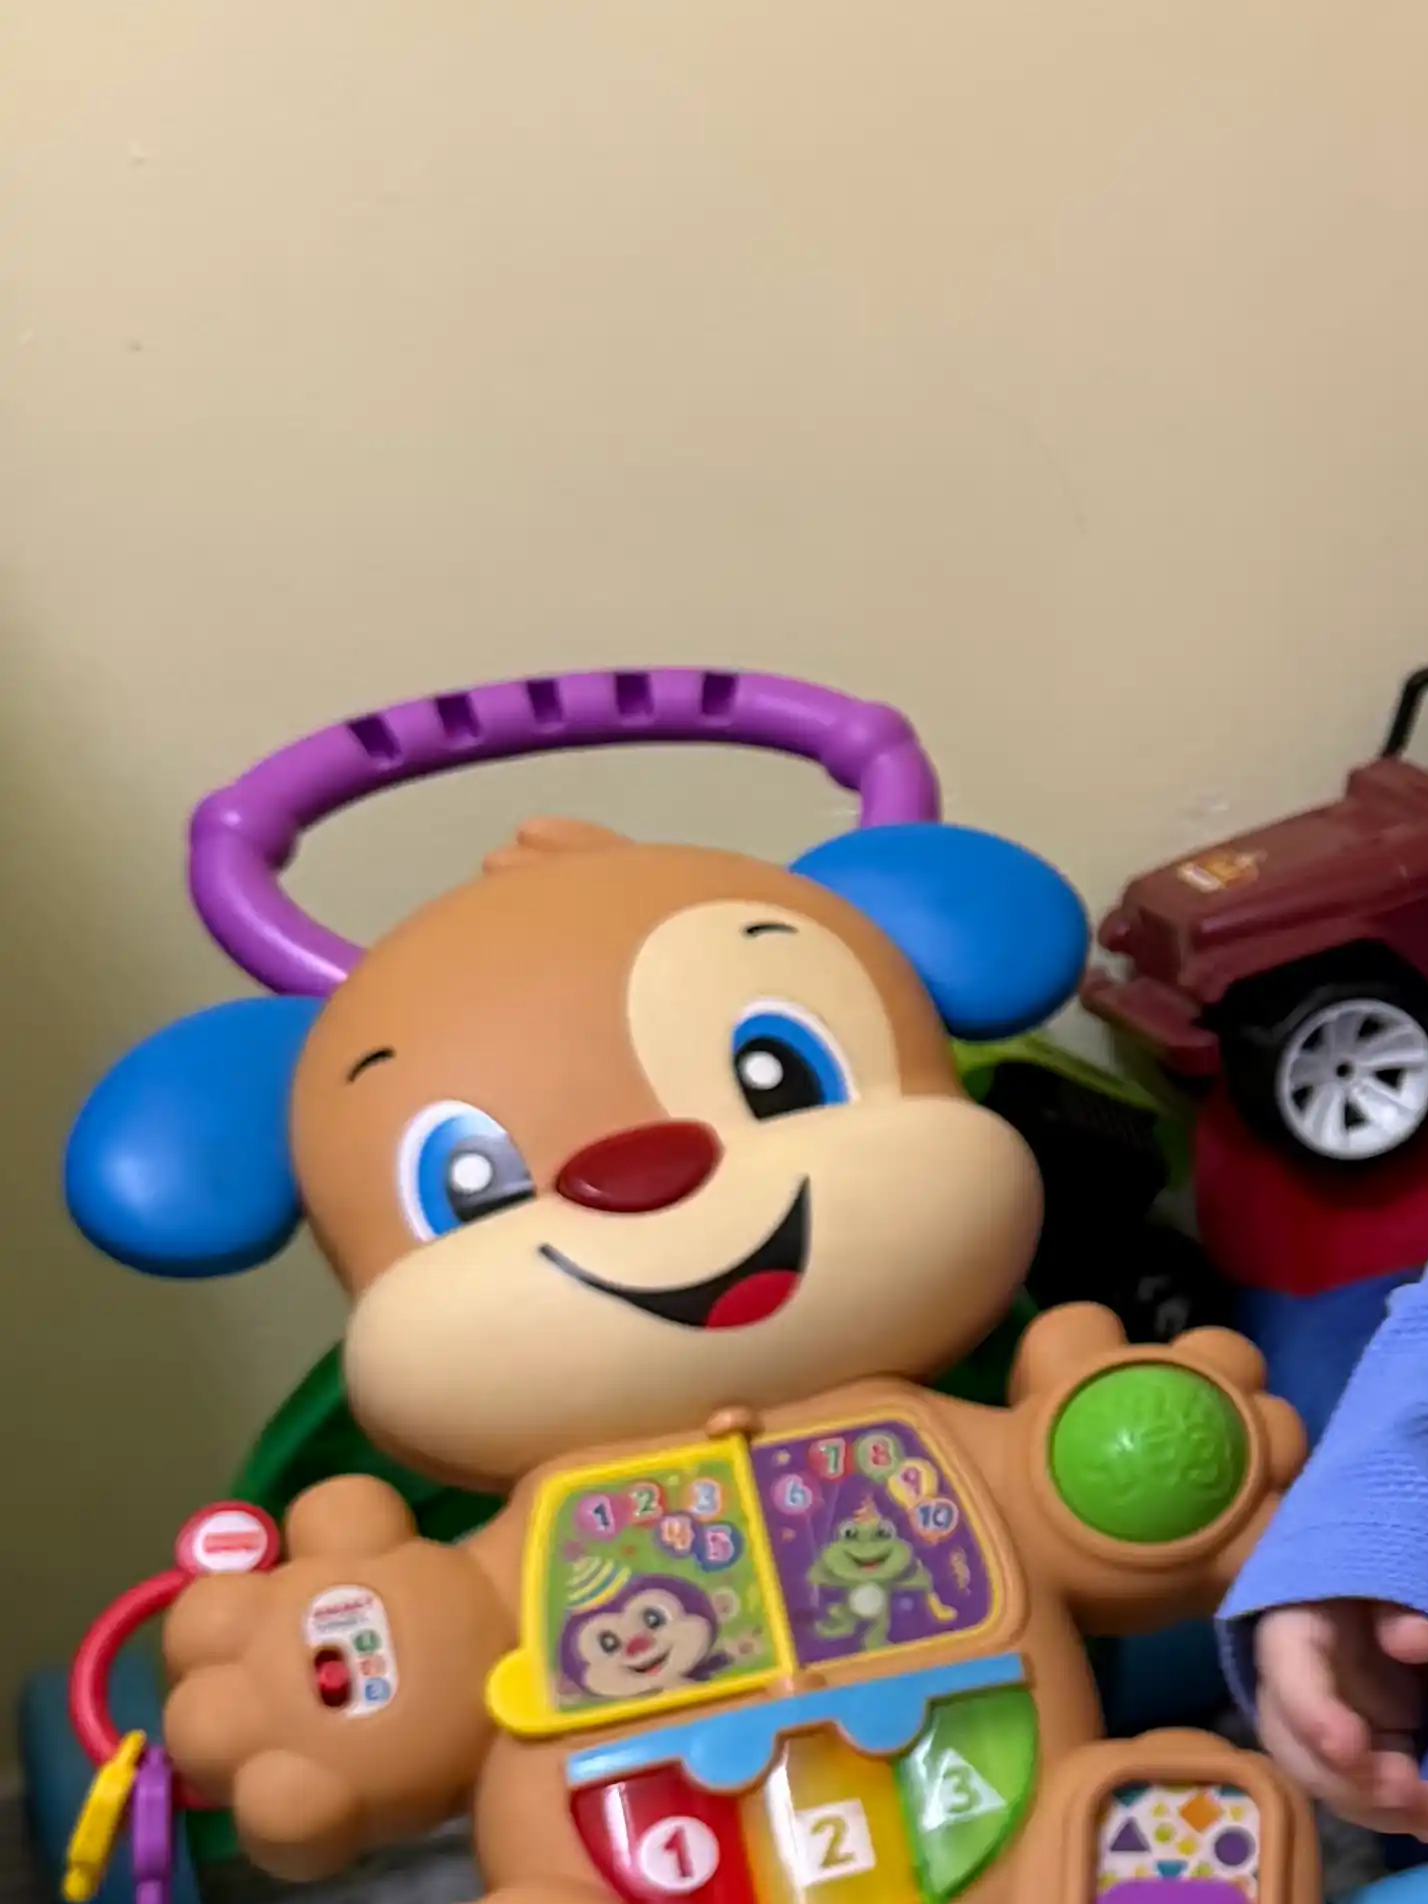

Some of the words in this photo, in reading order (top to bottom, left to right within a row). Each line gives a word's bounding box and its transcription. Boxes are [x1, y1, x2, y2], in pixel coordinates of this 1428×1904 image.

[593, 1503, 615, 1533] 1
[629, 1485, 654, 1517] 2
[694, 1480, 721, 1517] 3
[782, 1478, 812, 1510] 6
[818, 1437, 849, 1476] 7
[868, 1439, 893, 1469] 8
[902, 1465, 924, 1498] 9
[917, 1501, 955, 1531] 10
[660, 1516, 692, 1551] 4
[704, 1524, 733, 1563] 5
[661, 1824, 694, 1880] 1
[809, 1814, 855, 1871] 2
[943, 1764, 982, 1813] 3
